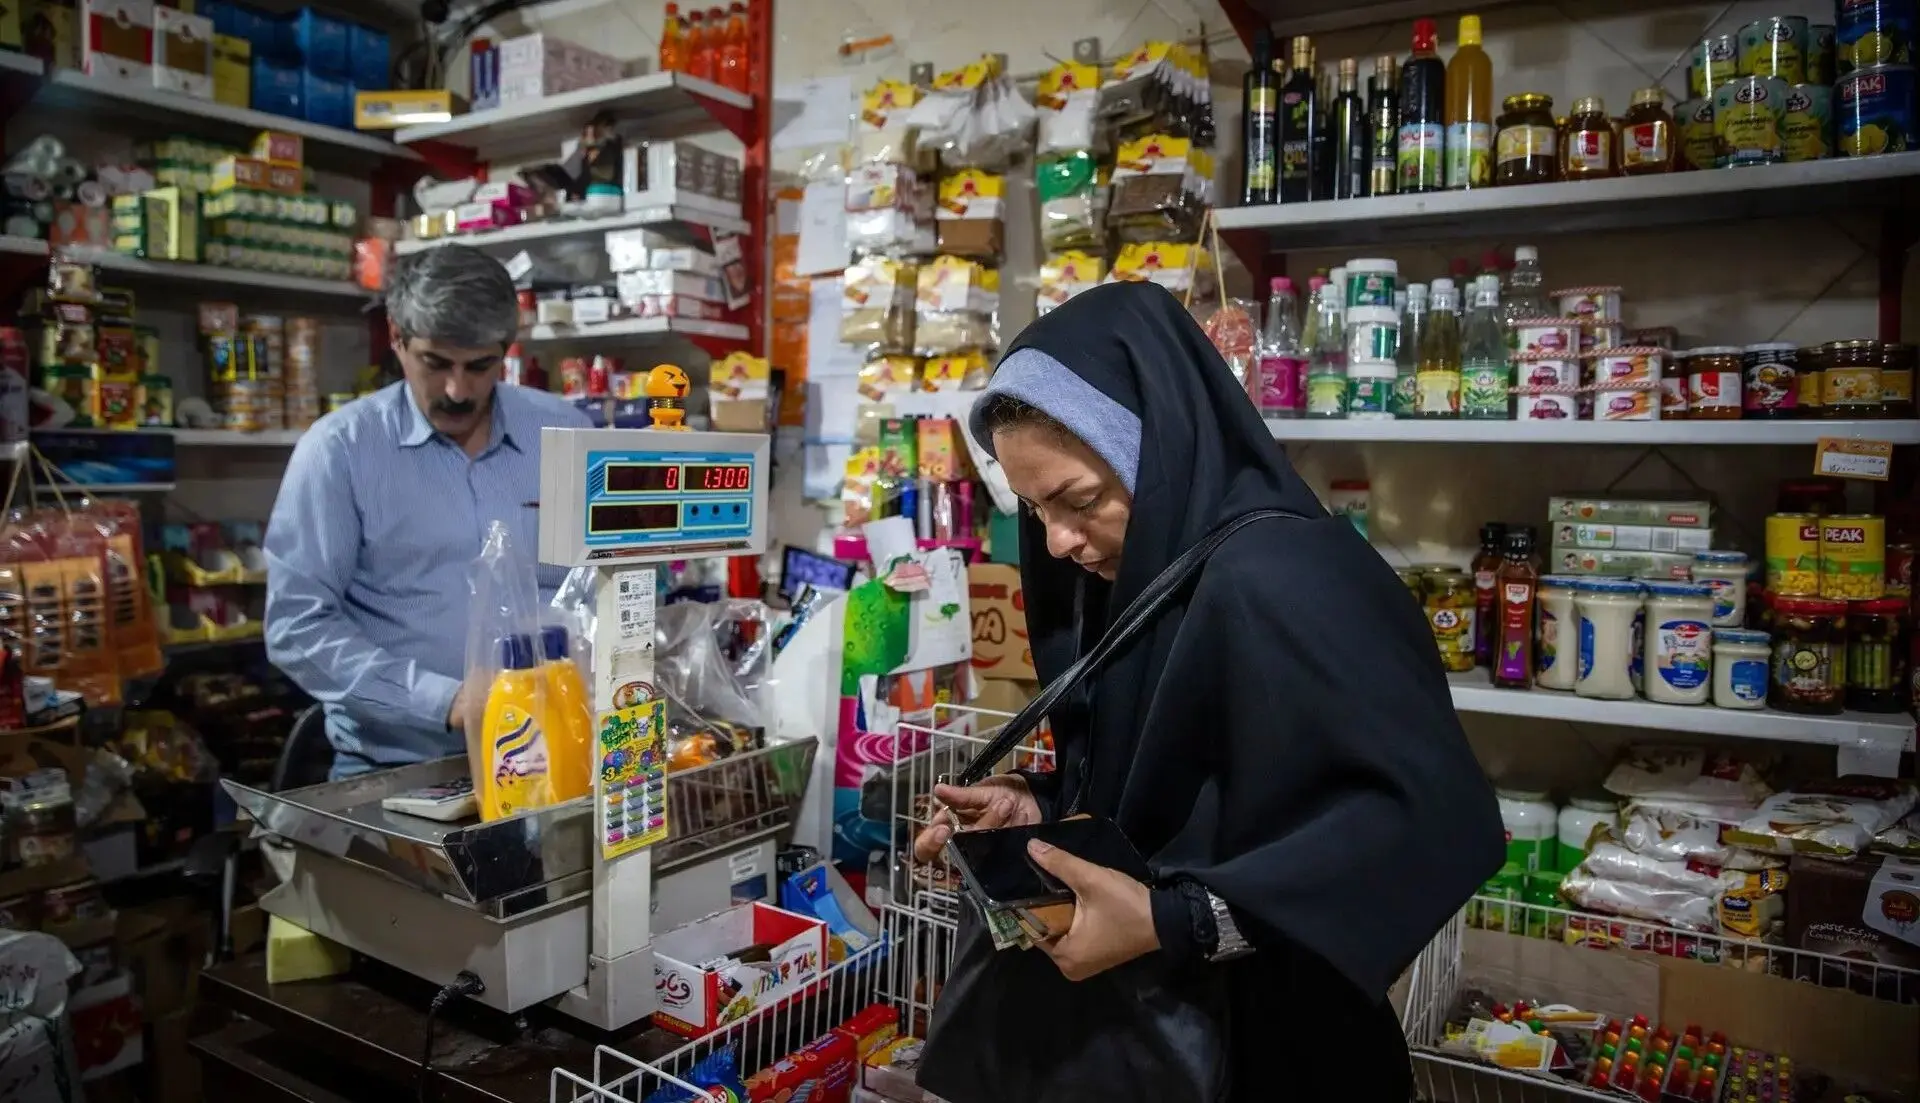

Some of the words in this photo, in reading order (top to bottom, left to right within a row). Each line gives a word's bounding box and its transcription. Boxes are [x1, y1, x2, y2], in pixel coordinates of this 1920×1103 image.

[1843, 77, 1884, 99] PEAK
[665, 467, 678, 489] 0
[1824, 528, 1863, 542] PEAK
